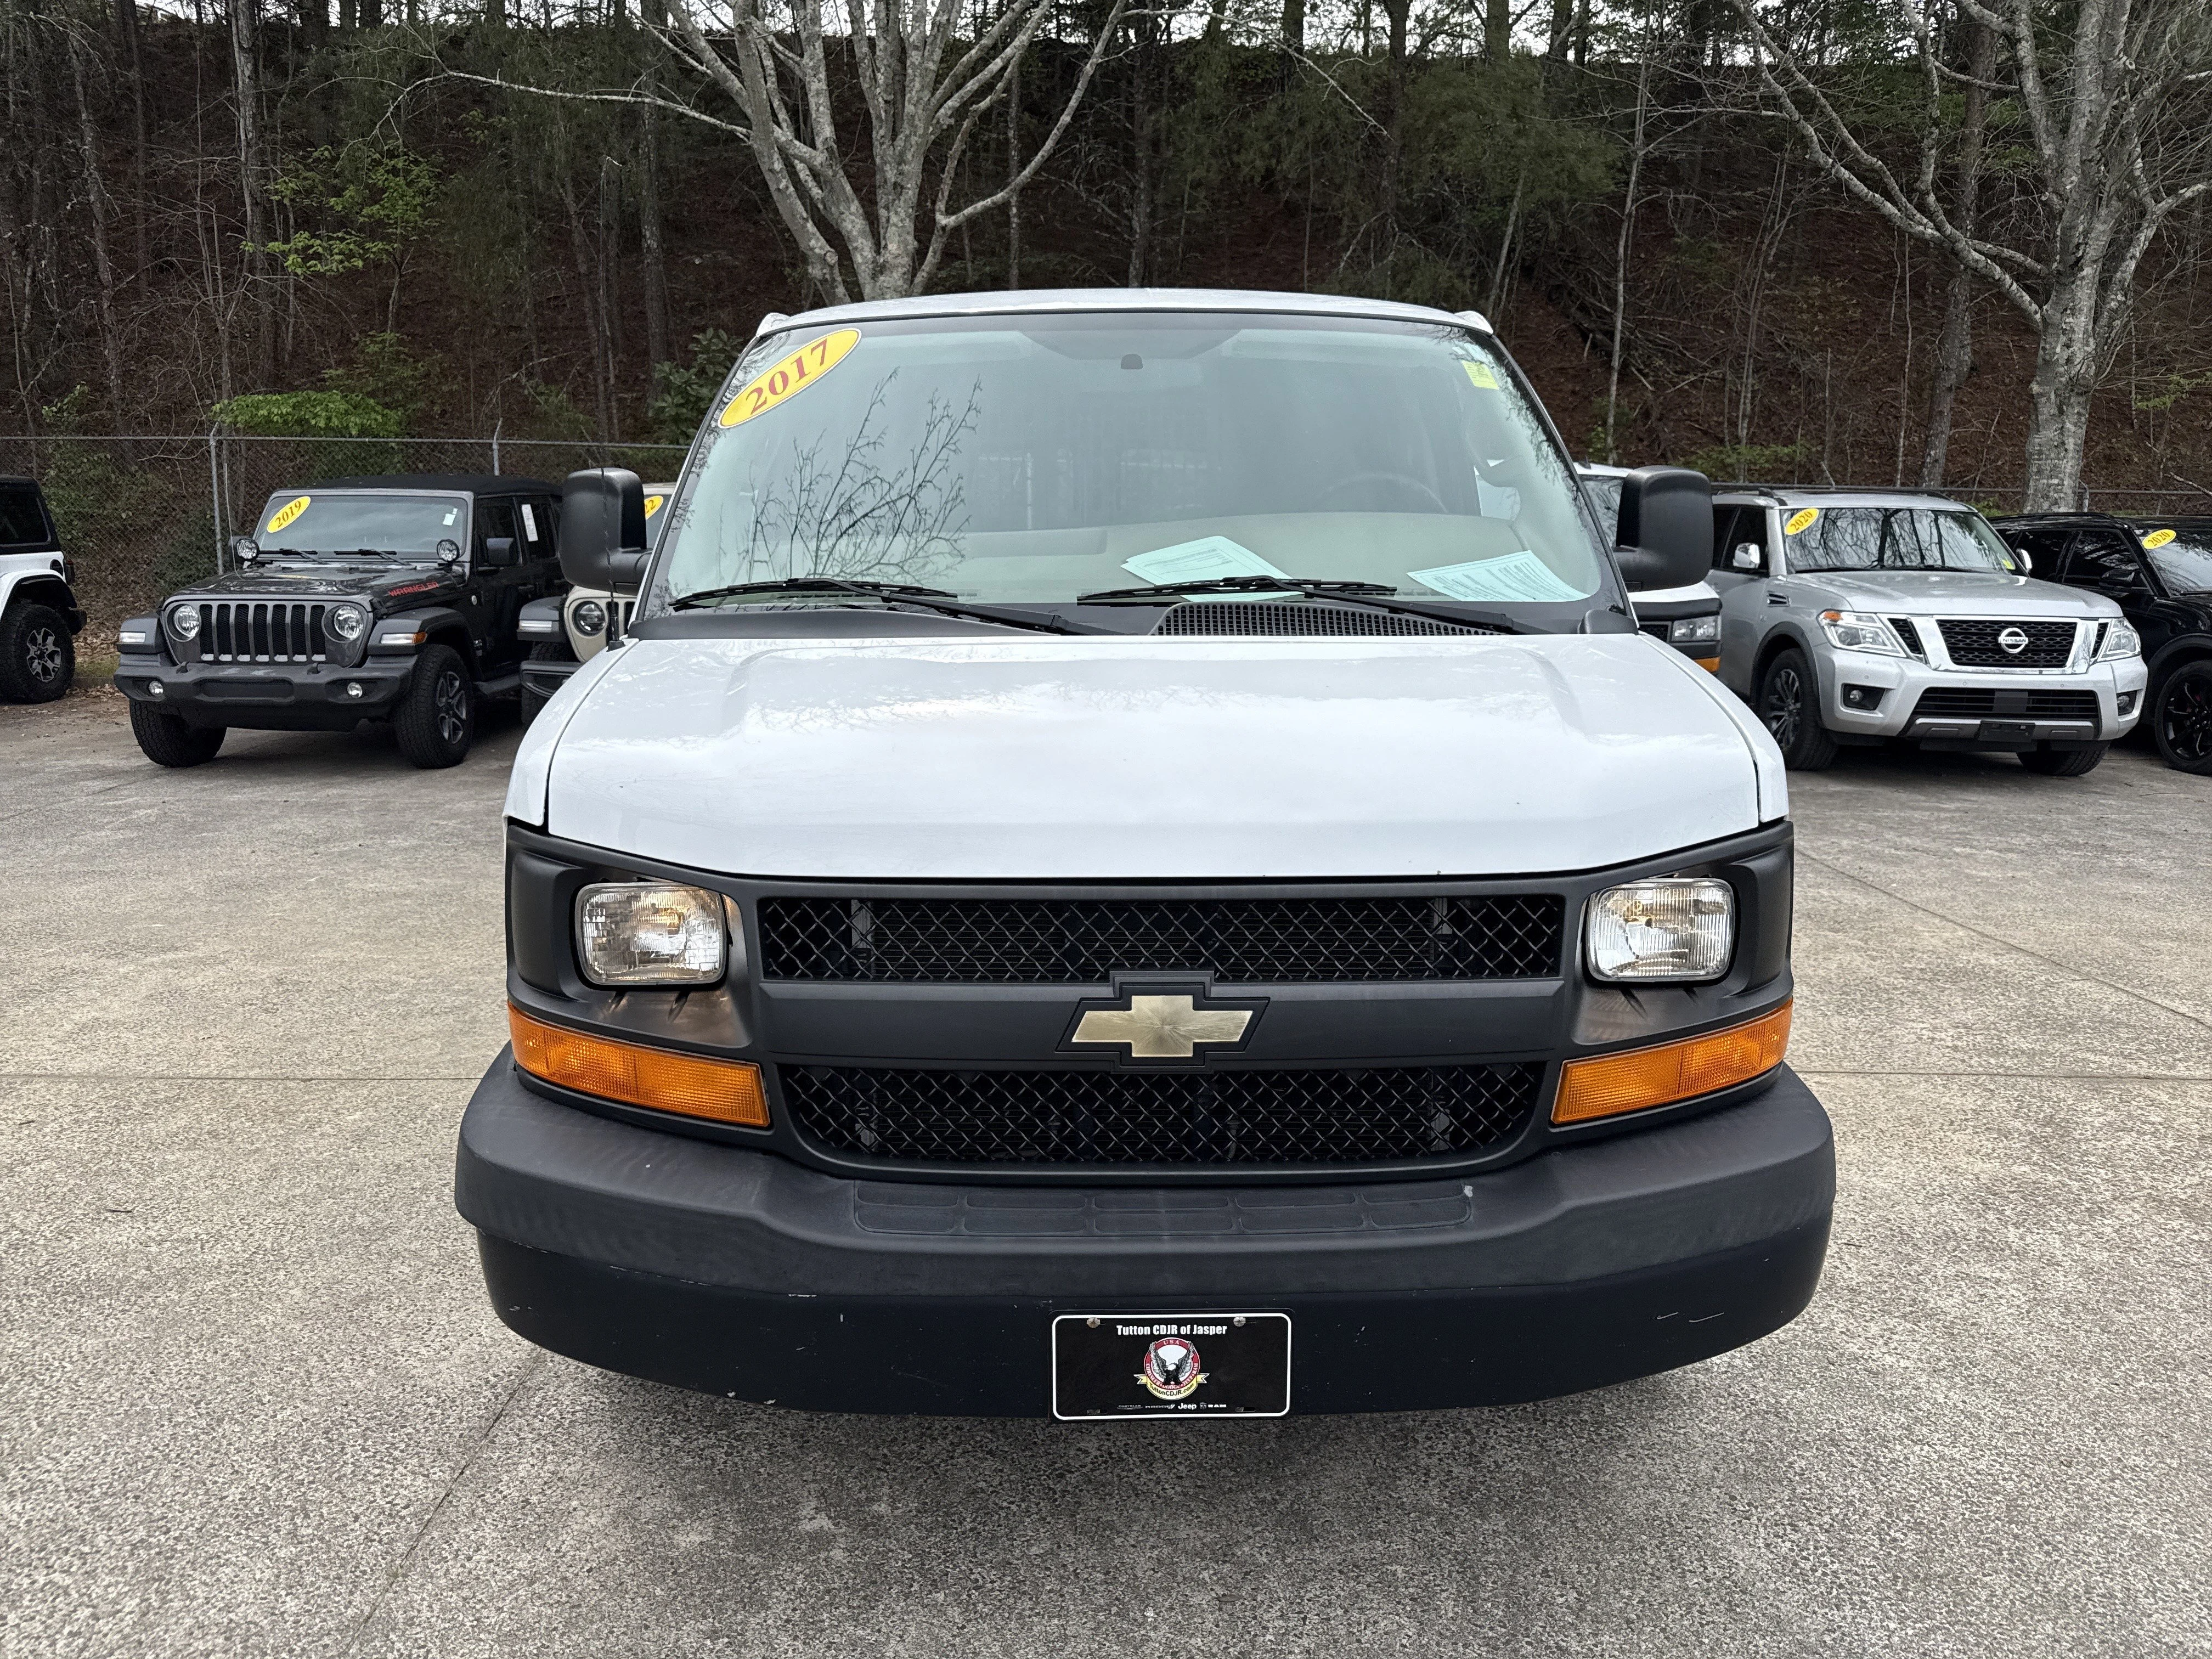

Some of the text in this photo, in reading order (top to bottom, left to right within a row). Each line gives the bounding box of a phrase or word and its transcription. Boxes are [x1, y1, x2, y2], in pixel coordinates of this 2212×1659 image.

[746, 338, 828, 416] 2017
[275, 500, 301, 528] 2019
[1790, 511, 1813, 531] 2020
[2148, 531, 2170, 546] 2020
[388, 581, 439, 597] WRANGLER
[1116, 1324, 1227, 1335] Tutton CDJR of Jasper
[1149, 1382, 1194, 1396] TuttonCDJR.com
